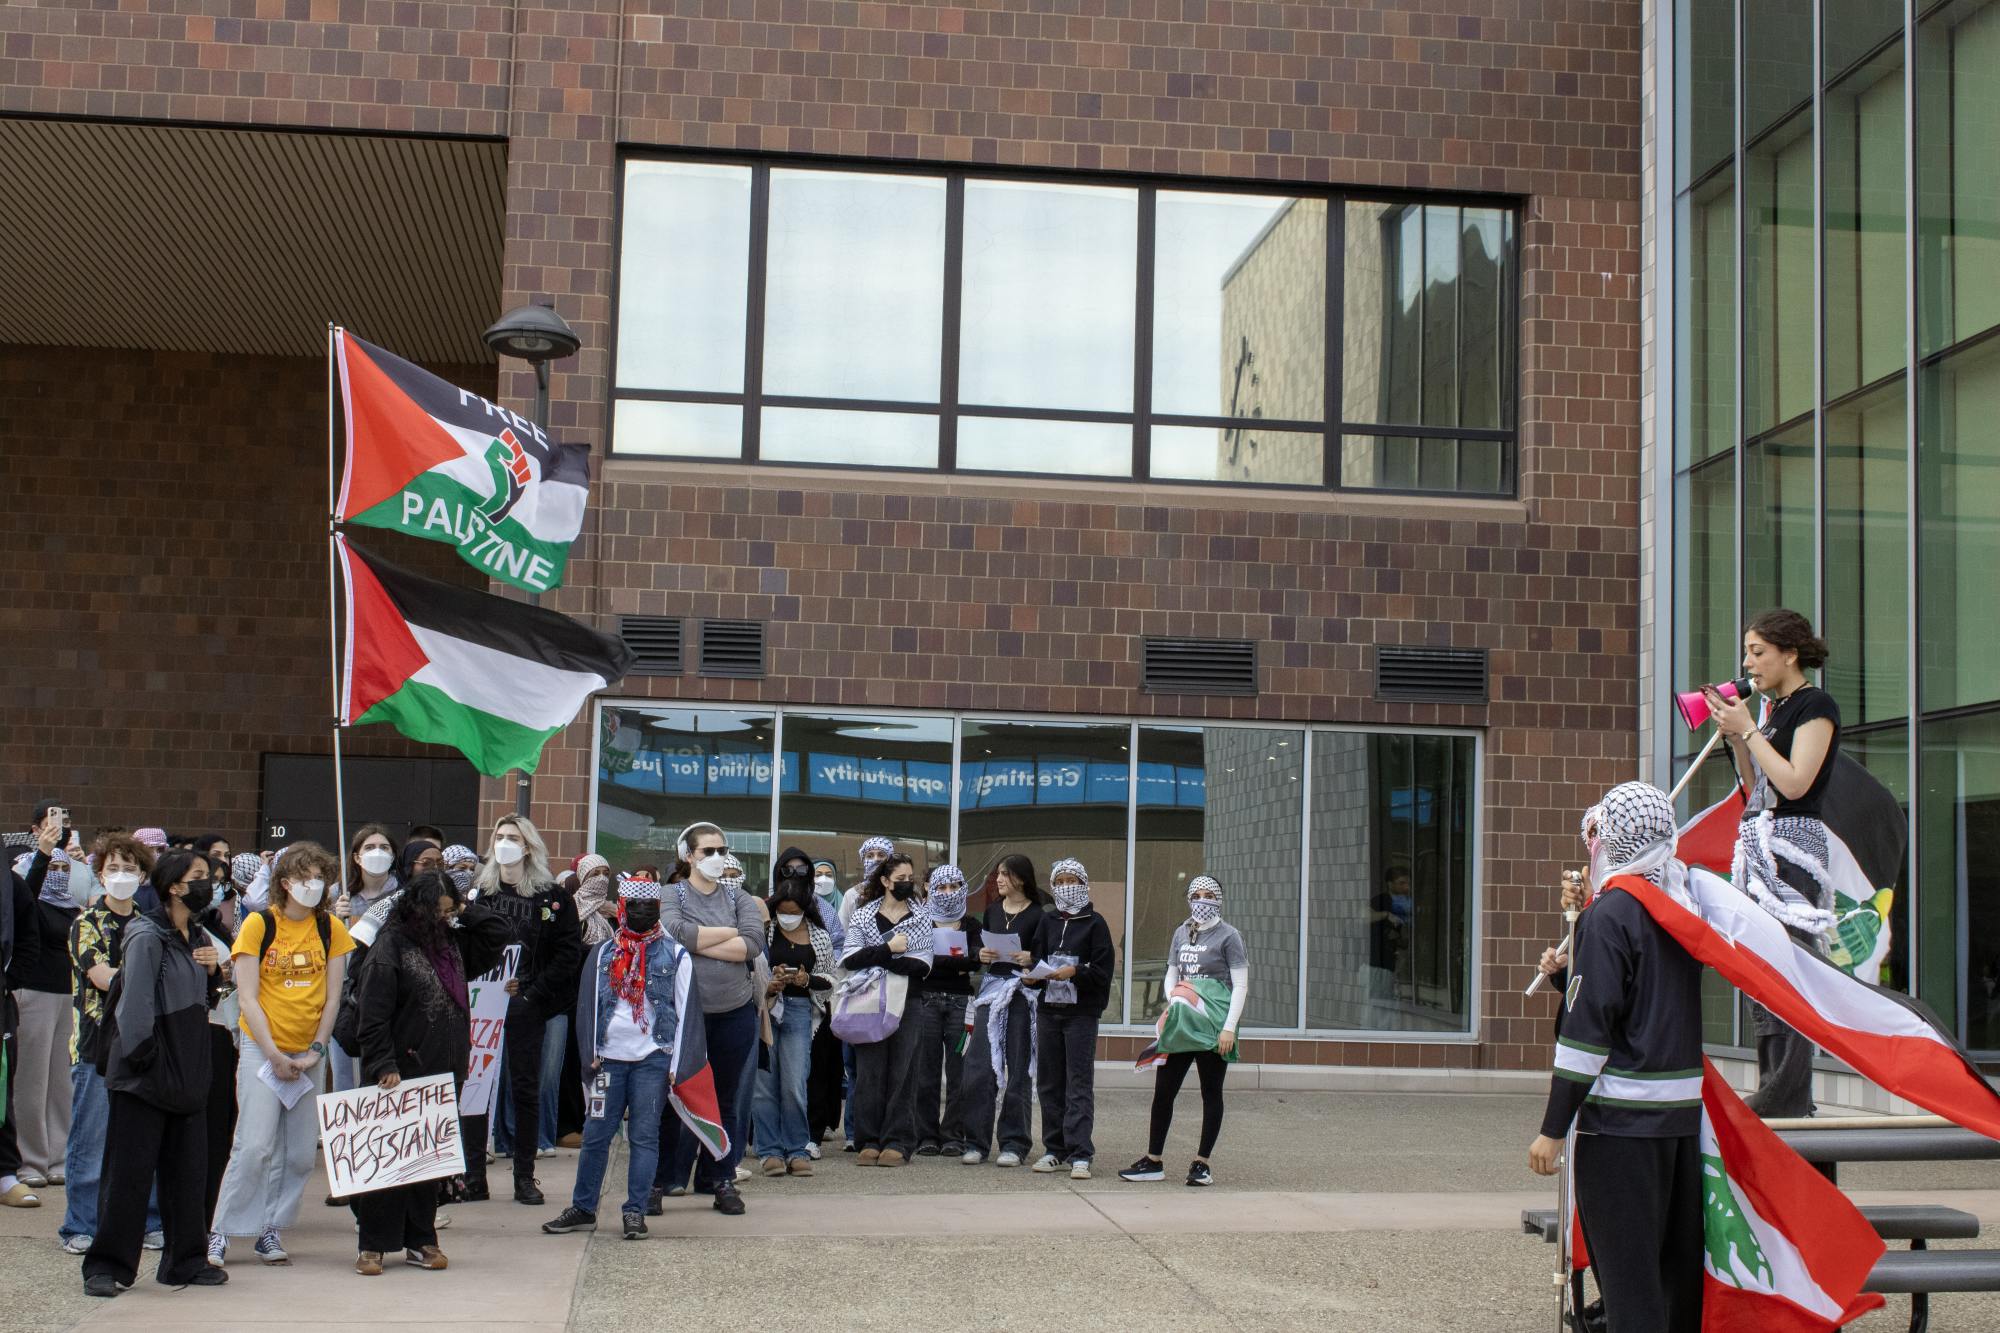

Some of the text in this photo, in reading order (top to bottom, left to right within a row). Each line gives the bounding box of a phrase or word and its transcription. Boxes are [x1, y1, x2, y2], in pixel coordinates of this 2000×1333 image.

[458, 387, 549, 451] FREE
[401, 491, 555, 591] PALSTINE
[271, 825, 286, 838] 10
[1180, 952, 1198, 963] KIDS
[1186, 963, 1200, 974] NOT
[323, 1081, 456, 1131] LONG LIVE THE
[330, 1113, 459, 1187] RESISTANCE
